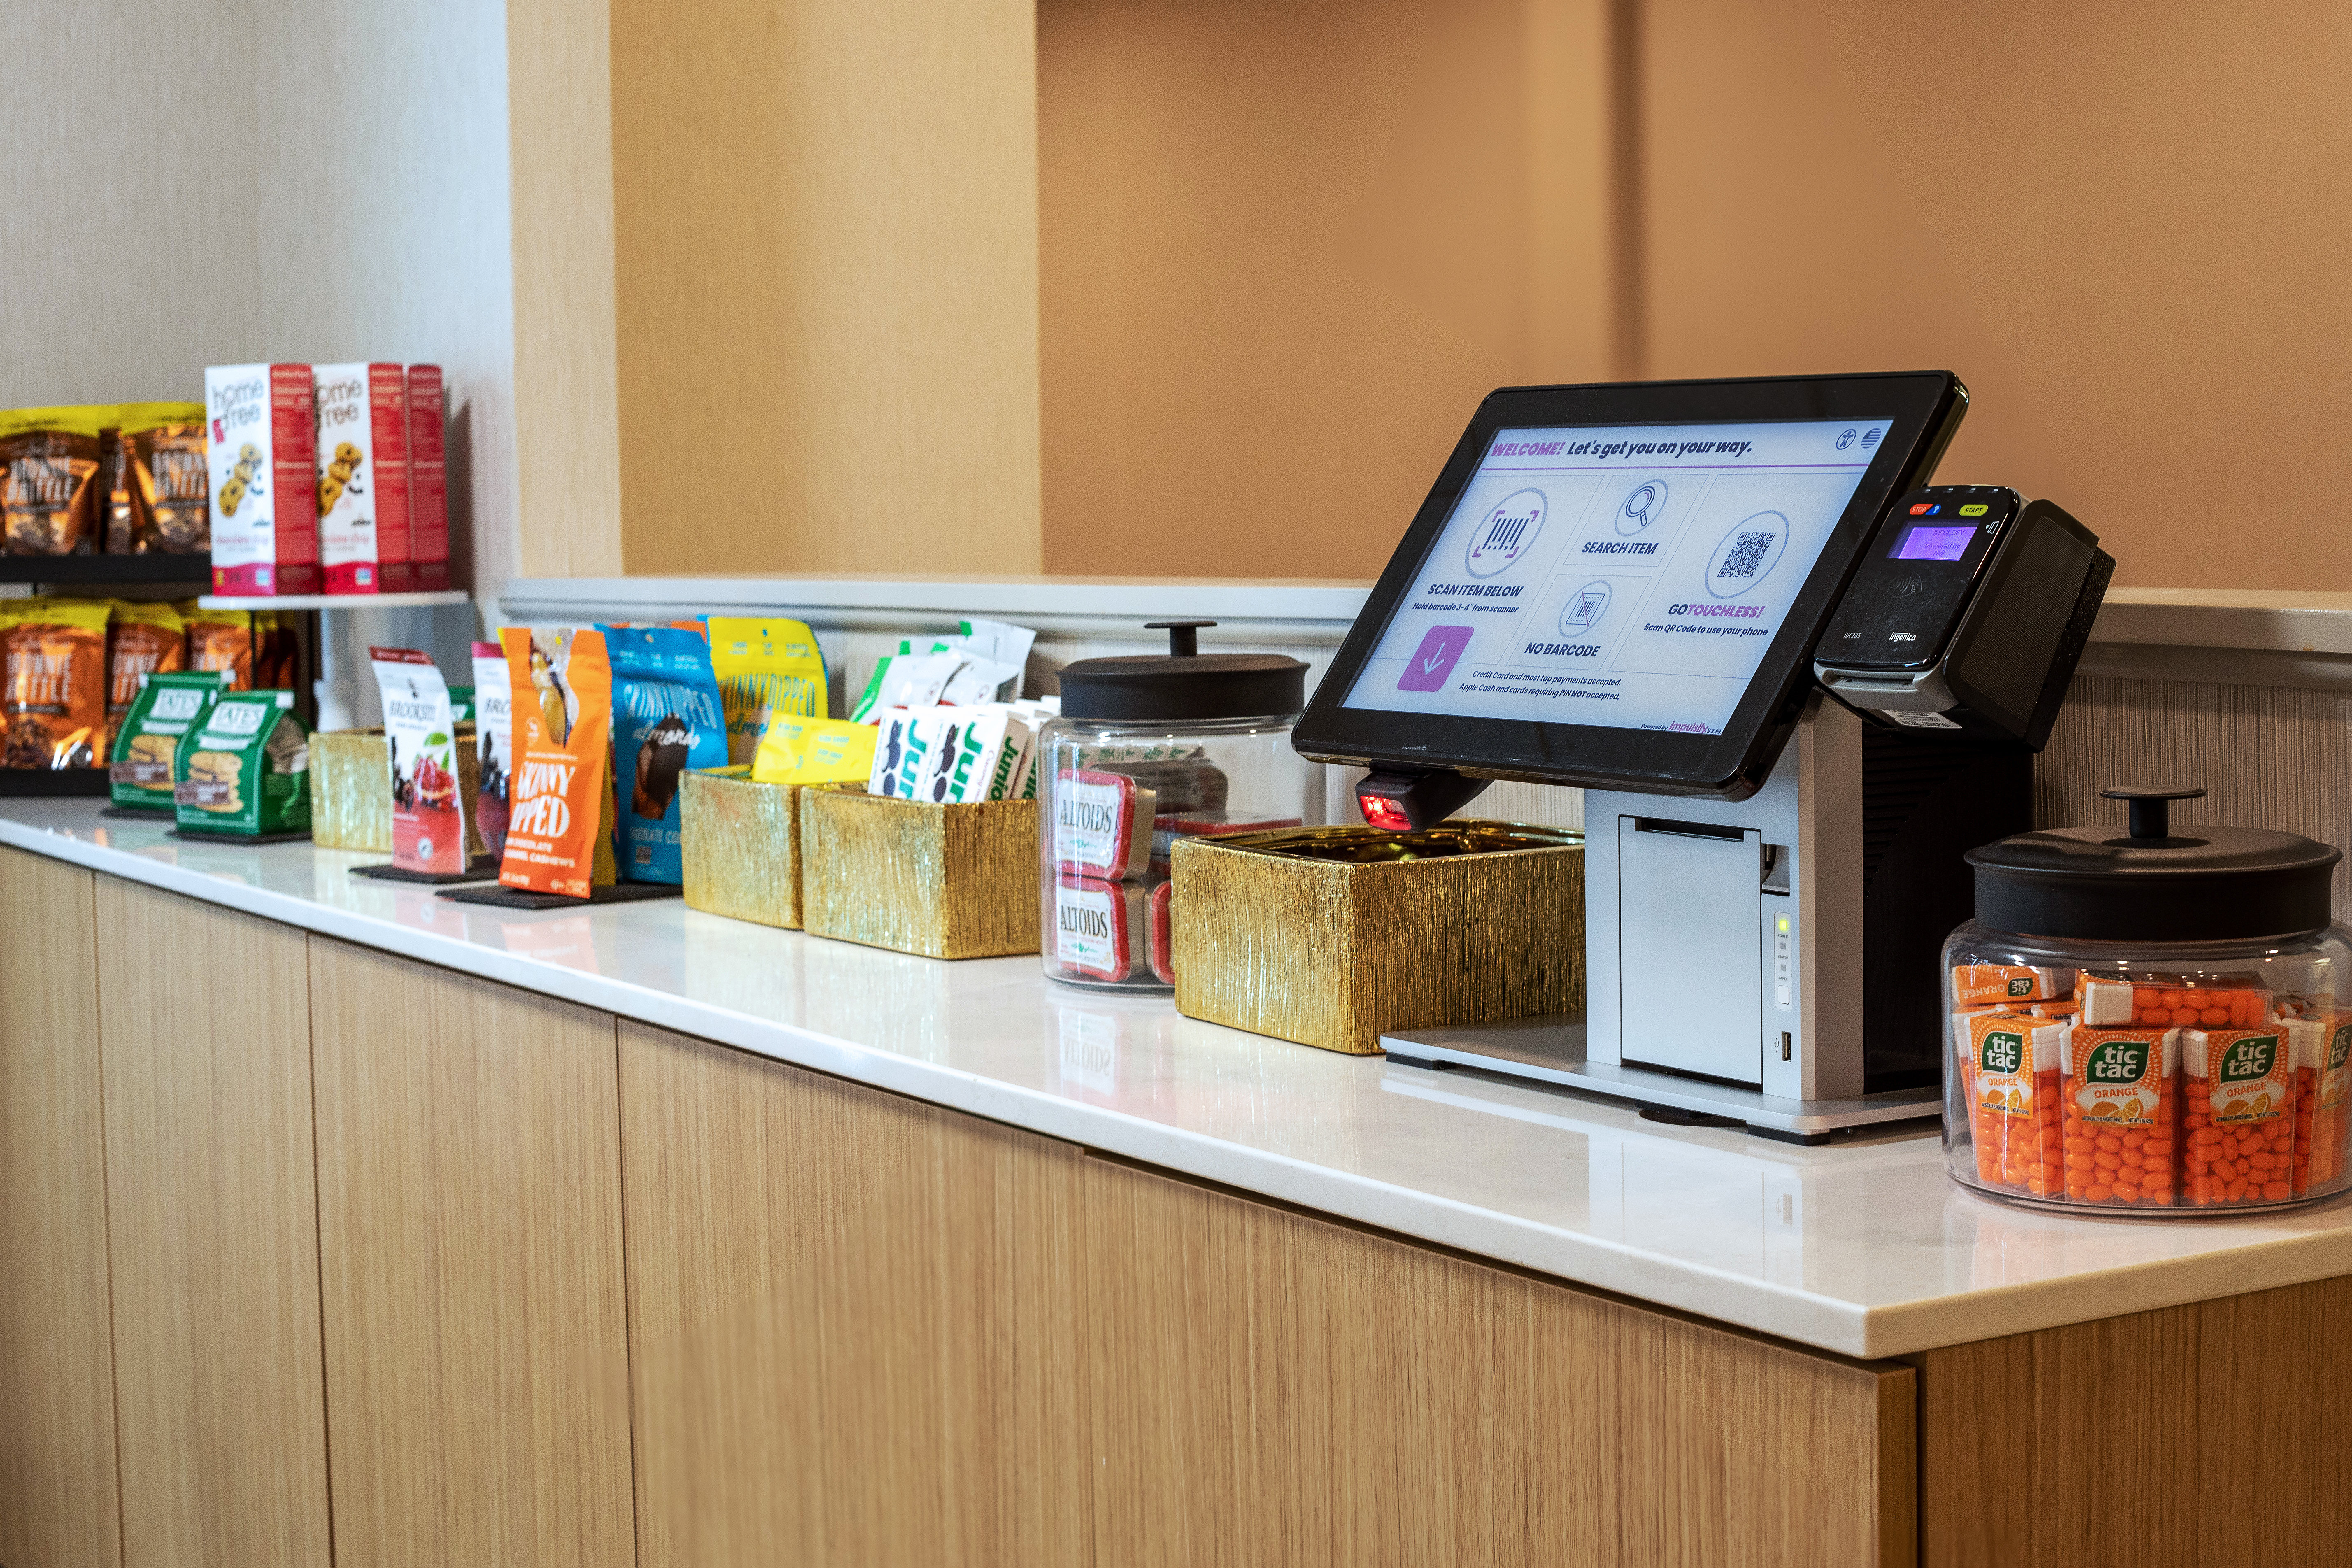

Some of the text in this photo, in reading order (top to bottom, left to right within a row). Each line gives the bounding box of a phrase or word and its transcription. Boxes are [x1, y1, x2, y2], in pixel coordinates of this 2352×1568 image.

[317, 379, 363, 403] ome
[1491, 439, 1752, 459] WELCOME! Let's get you on your way.
[1582, 542, 1659, 554] SEARCH ITEM
[1428, 584, 1524, 597] SCAN ITEM BELOW
[1428, 603, 1456, 611] barcode
[1472, 603, 1491, 612] from
[1644, 623, 1664, 631] Scan
[1664, 624, 1677, 633] QR
[1676, 624, 1697, 633] Code
[1697, 625, 1706, 633] to
[1720, 627, 1742, 637] your
[1740, 627, 1768, 637] phone
[1889, 632, 1917, 642] ingenico
[1524, 642, 1601, 657] NO BARCODE
[1540, 675, 1554, 684] tap
[1551, 676, 1587, 685] payments
[1587, 679, 1622, 688] accepted.
[1459, 683, 1478, 692] Apple
[1528, 687, 1559, 698] requiring
[1586, 692, 1620, 701] accepted.
[989, 735, 1019, 801] Junio
[1059, 799, 1112, 833] ALTOIDS
[1061, 905, 1108, 939] ALTOIDS
[1961, 984, 2005, 998] ORANGE
[2012, 986, 2026, 995] tic
[1992, 1035, 2015, 1055] tic
[2336, 1029, 2349, 1049] tic
[1987, 1049, 2015, 1069] tac
[2104, 1045, 2138, 1064] tic
[2237, 1041, 2268, 1061] tic
[2331, 1047, 2347, 1064] tac
[2095, 1061, 2136, 1078] tac
[2228, 1059, 2266, 1076] tac
[1988, 1077, 2018, 1086] ORANGE
[2226, 1082, 2267, 1098] ORANGE
[2094, 1087, 2138, 1098] ORANGE
